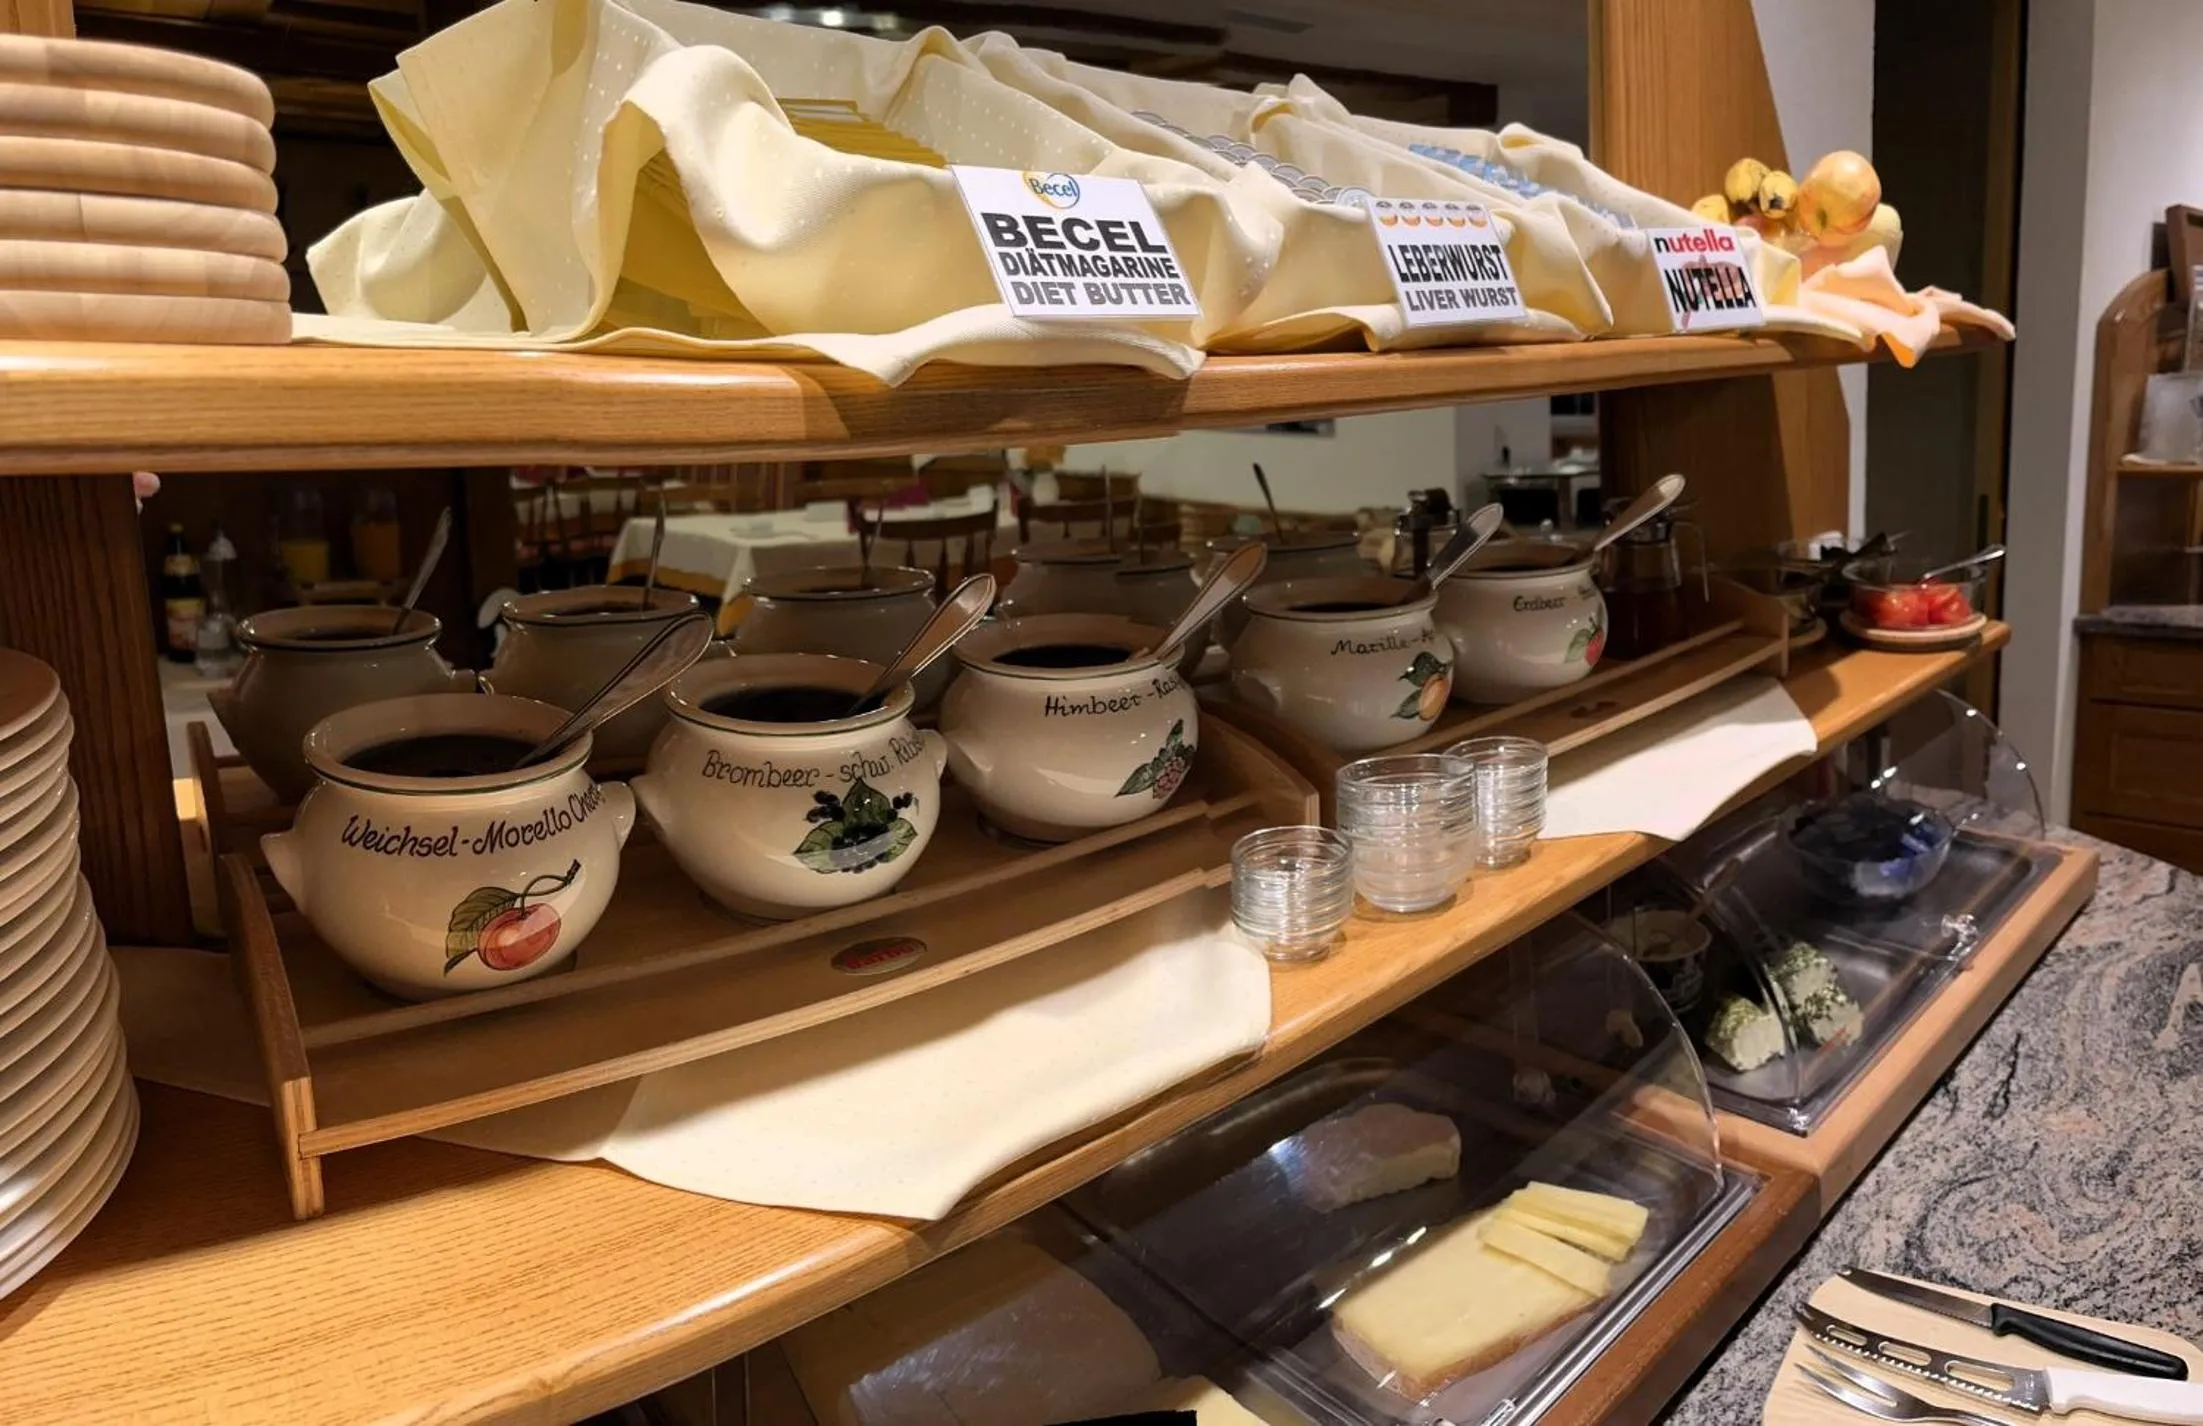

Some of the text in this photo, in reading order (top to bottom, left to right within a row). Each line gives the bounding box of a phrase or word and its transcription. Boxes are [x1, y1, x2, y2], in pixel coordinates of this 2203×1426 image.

[1029, 177, 1078, 197] Becel
[981, 212, 1169, 254] BECEL
[1654, 228, 1735, 253] nutella
[999, 248, 1180, 279] DIÄTMAGARINE
[1388, 244, 1509, 283] LEBERWURST
[1010, 281, 1191, 306] DIET BUTTER
[1405, 287, 1519, 312] LIVER WURST
[1664, 266, 1757, 313] NUTELLA
